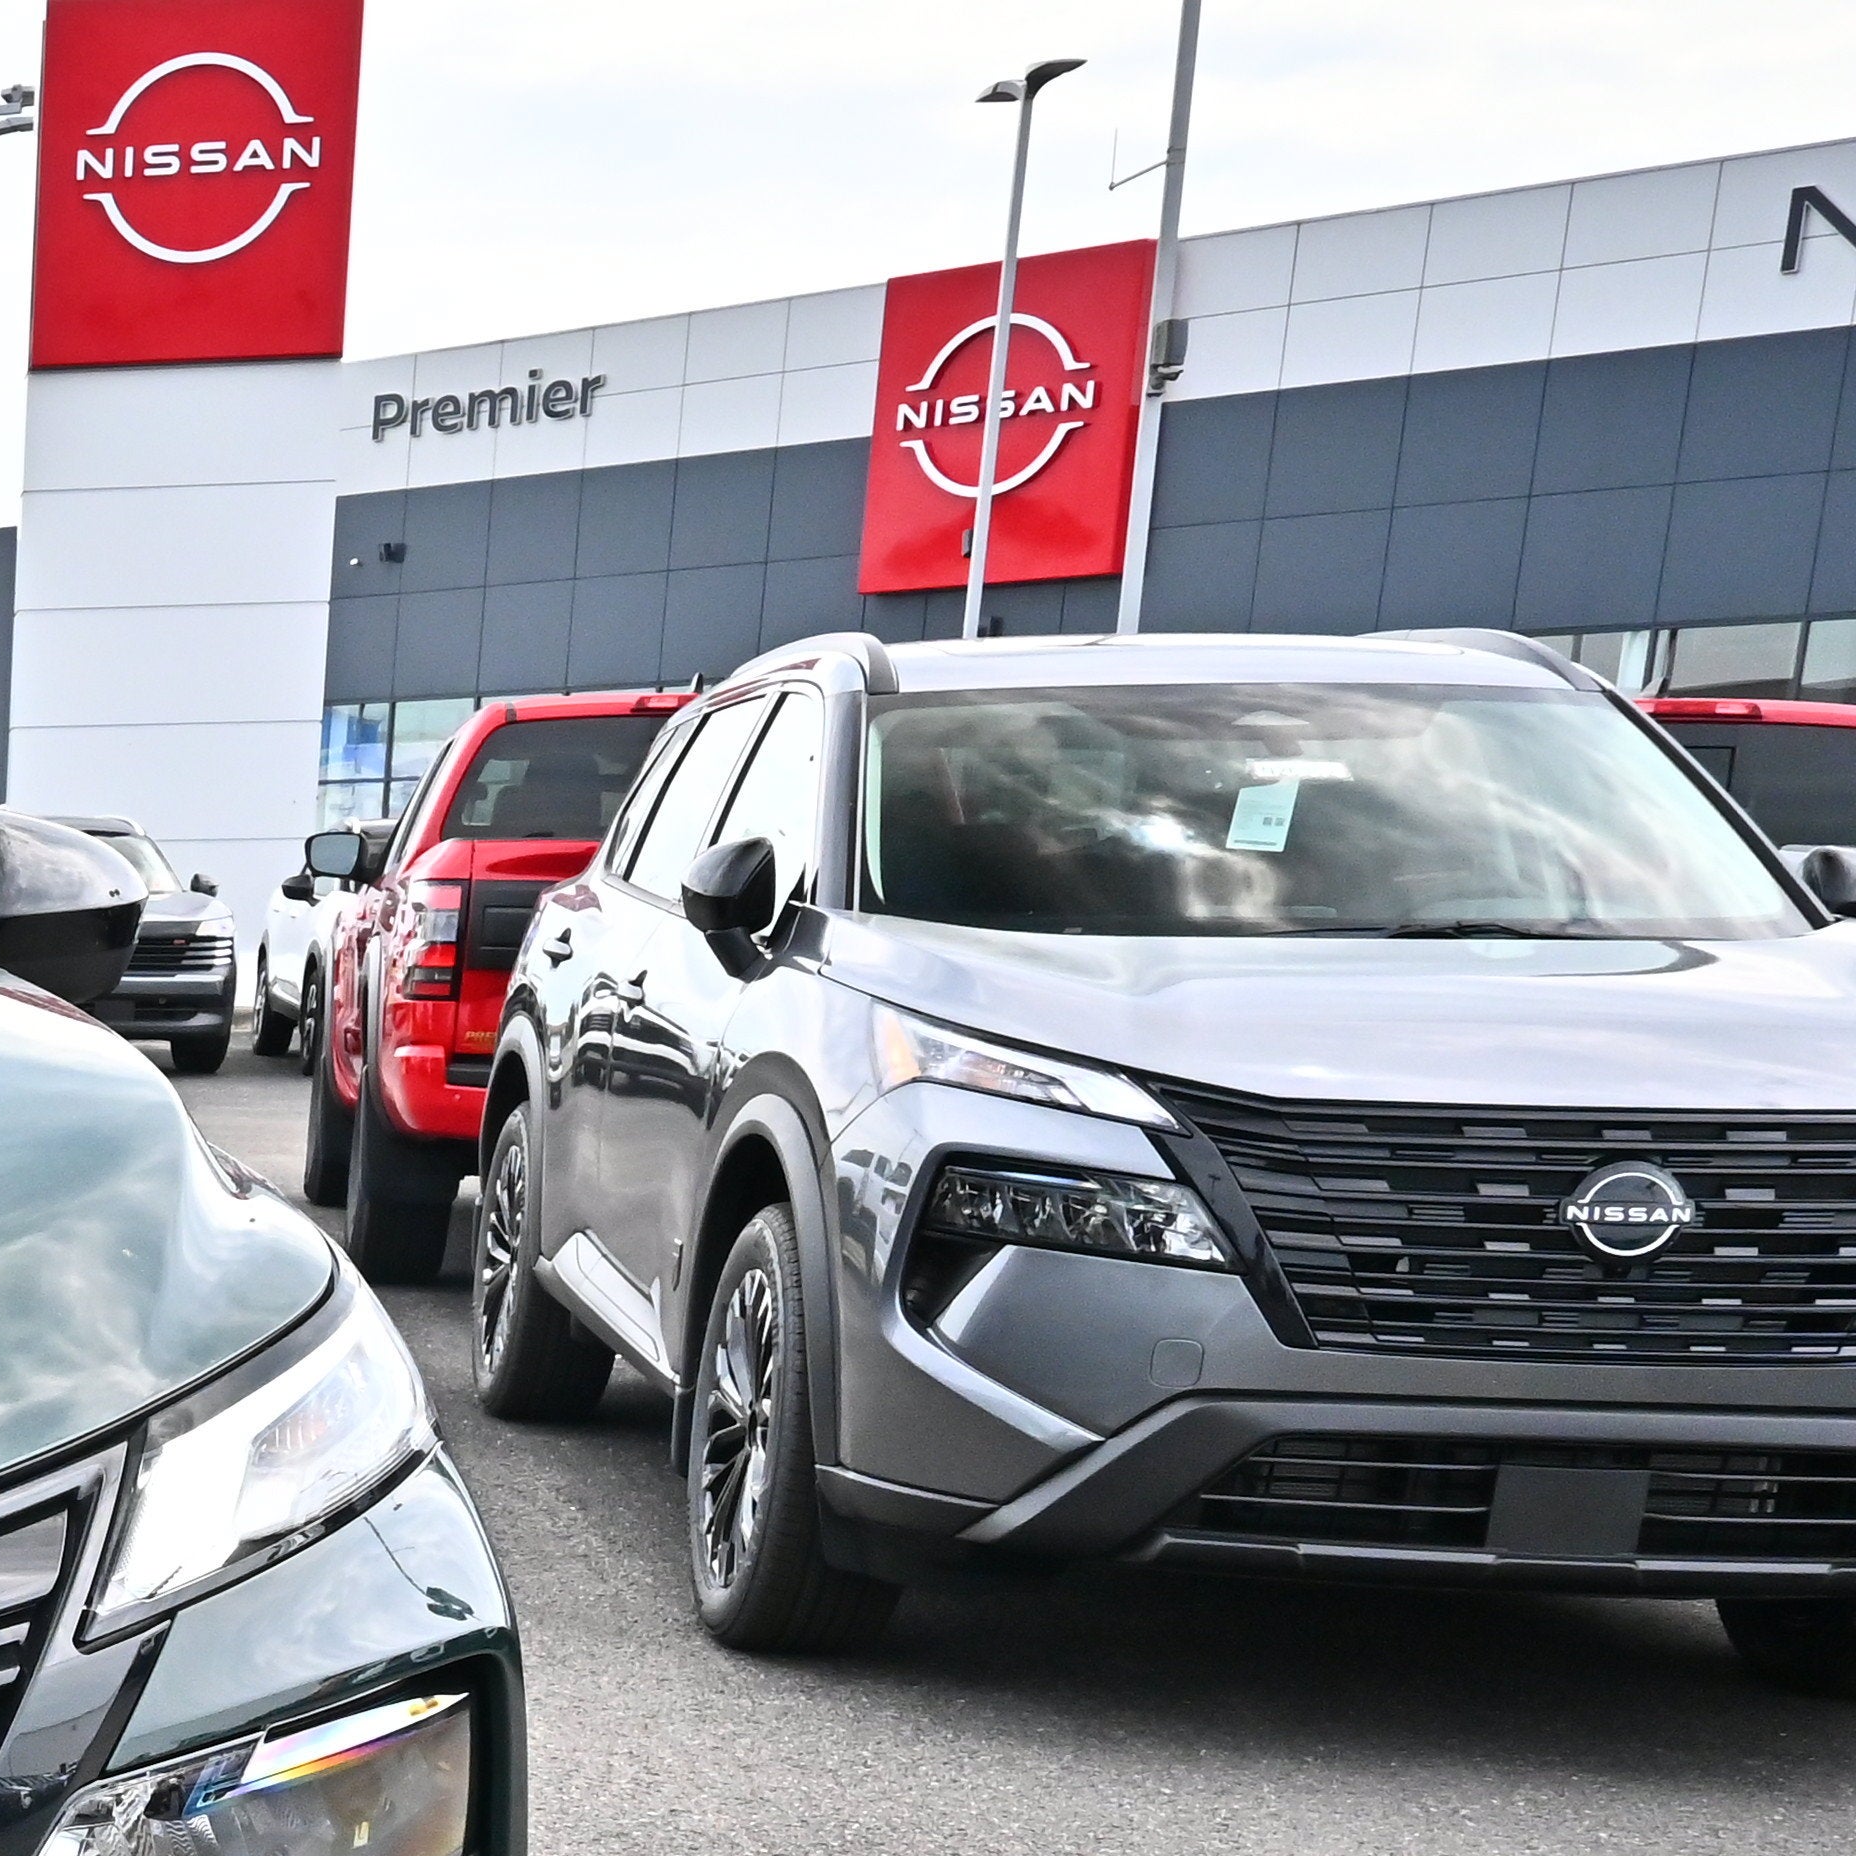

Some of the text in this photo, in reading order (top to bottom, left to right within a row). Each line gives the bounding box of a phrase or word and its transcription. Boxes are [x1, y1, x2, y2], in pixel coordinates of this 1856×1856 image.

[76, 136, 321, 181] NISSAN
[372, 368, 606, 442] Premier
[1566, 1205, 1691, 1222] NISSAN
